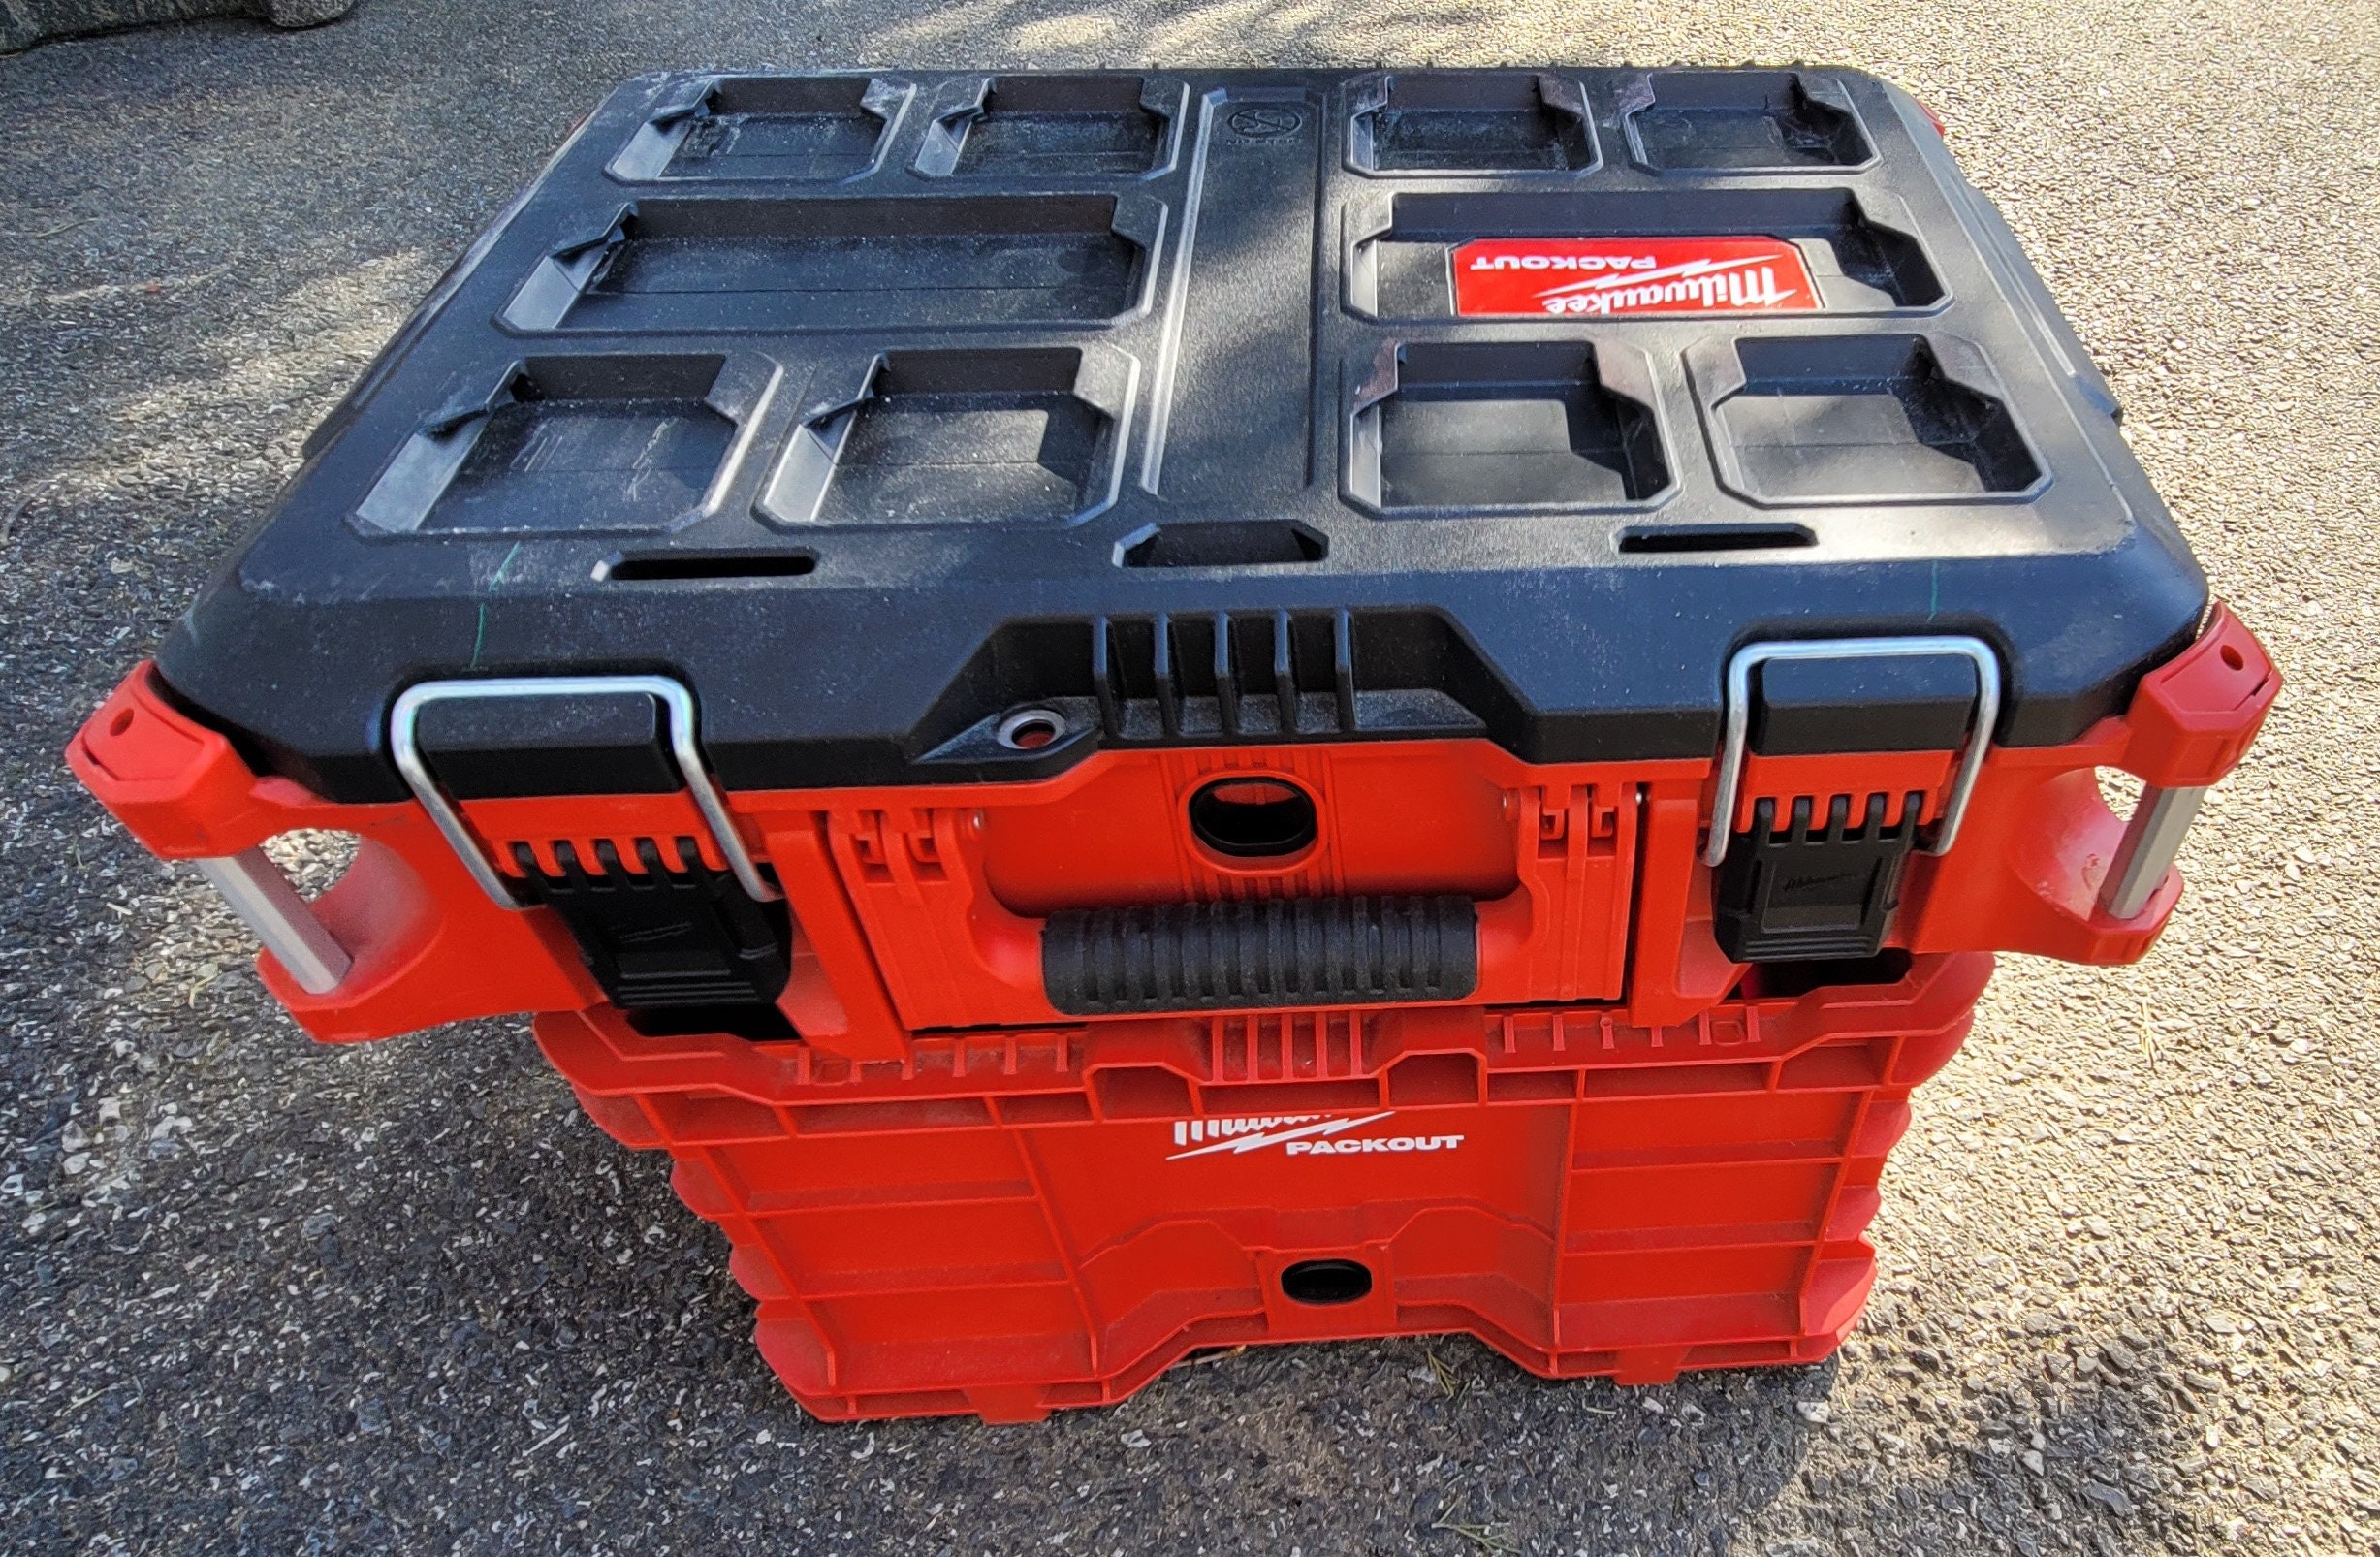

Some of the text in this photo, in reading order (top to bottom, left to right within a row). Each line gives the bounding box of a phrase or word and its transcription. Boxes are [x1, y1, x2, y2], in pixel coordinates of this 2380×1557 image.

[1470, 255, 1657, 270] PACKOUT
[1542, 266, 1797, 314] Milwaukee
[1286, 1134, 1465, 1156] PACKOUT
